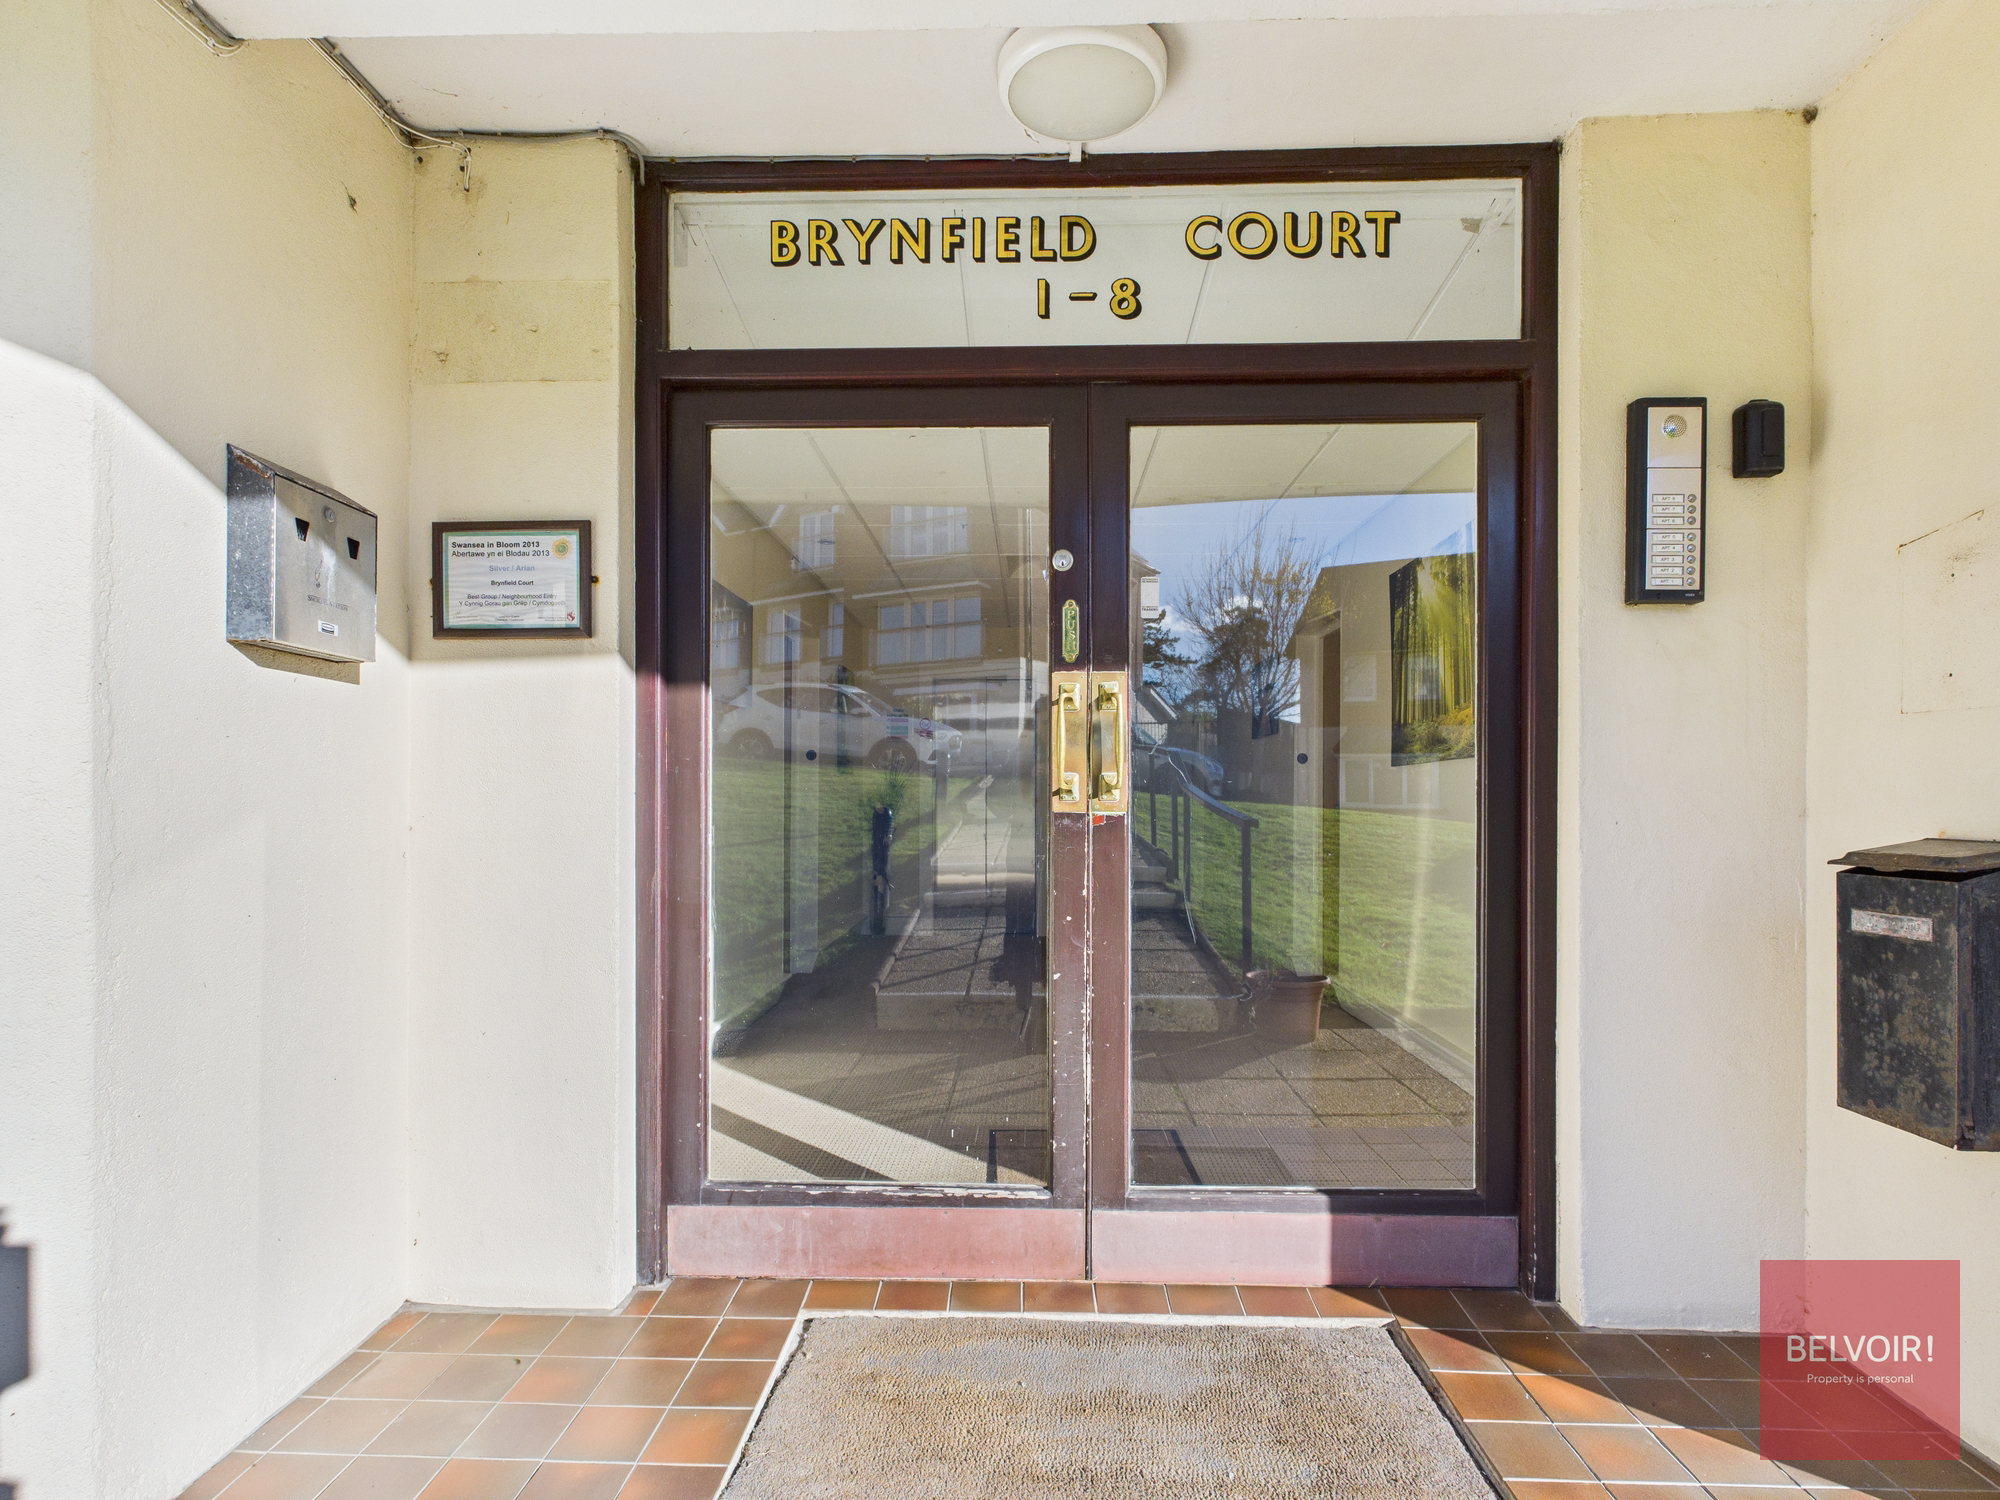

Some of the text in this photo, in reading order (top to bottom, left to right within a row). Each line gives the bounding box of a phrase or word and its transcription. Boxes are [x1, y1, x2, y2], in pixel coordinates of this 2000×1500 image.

[770, 210, 1401, 267] BRYNFIELD COURT
[451, 541, 485, 549] Swansea
[505, 549, 530, 557] Blodau
[532, 549, 550, 557] 2013
[1066, 610, 1076, 650] PUSH
